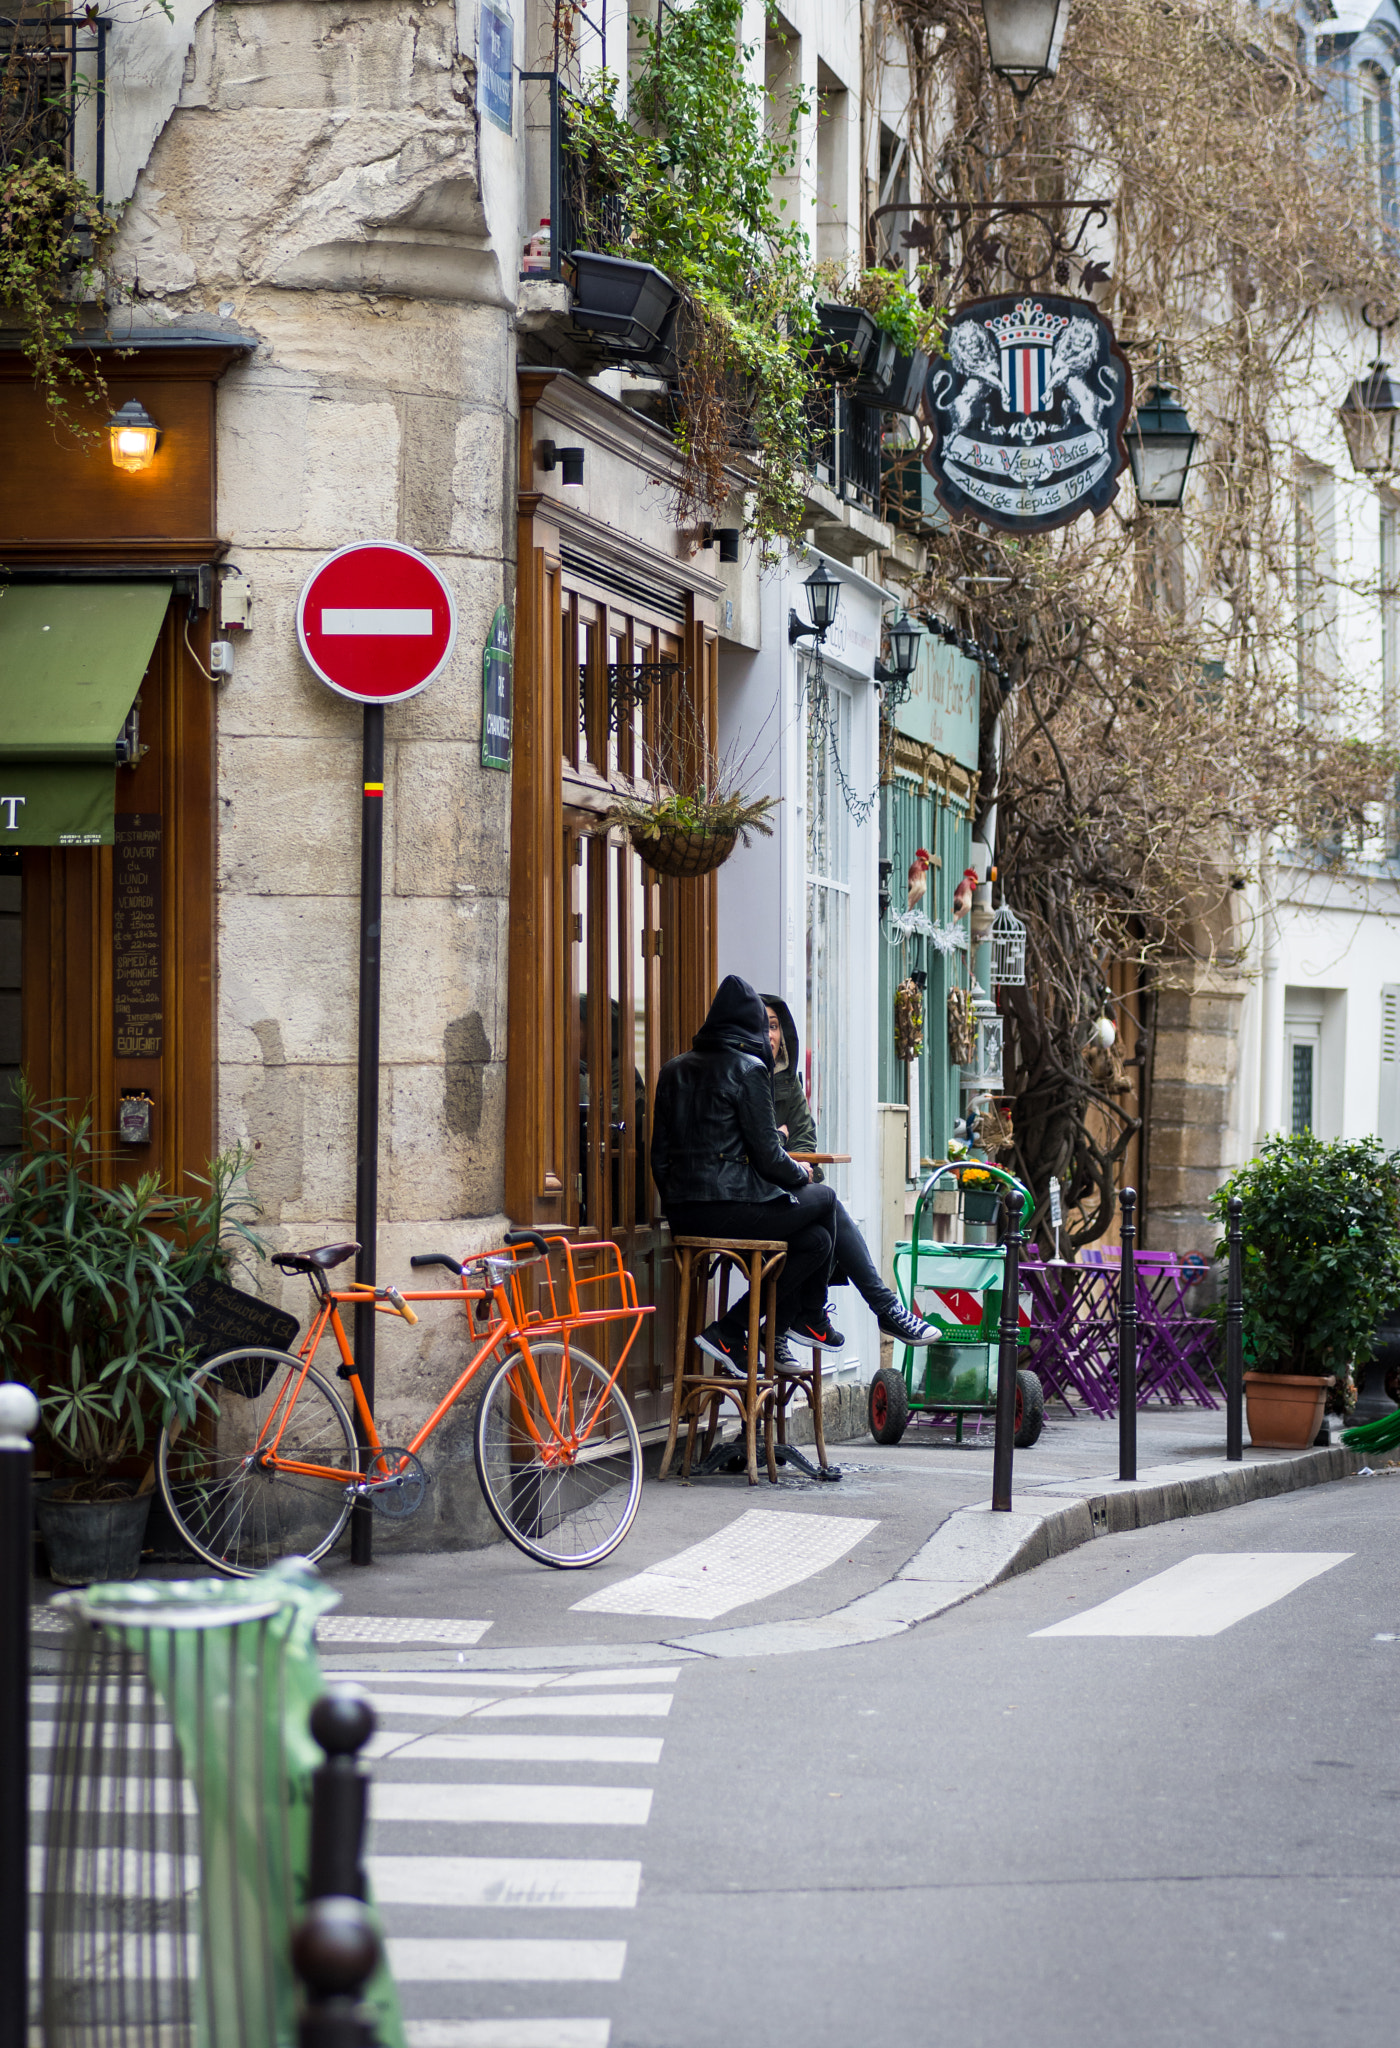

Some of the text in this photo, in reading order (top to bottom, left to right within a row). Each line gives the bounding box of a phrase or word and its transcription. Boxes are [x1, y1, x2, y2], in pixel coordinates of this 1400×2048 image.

[965, 442, 1088, 472] Au Vieux Paris
[956, 470, 1094, 512] Auberge depuis 1594
[115, 830, 161, 842] RESTAURANT
[123, 846, 157, 859] OUVERT
[127, 860, 141, 871] du
[119, 873, 148, 885] LUNDI
[126, 886, 141, 894] au
[118, 895, 154, 909] VENDREDI
[149, 954, 158, 966] et
[127, 1027, 143, 1036] AU
[117, 1037, 162, 1051] BOUGNAT
